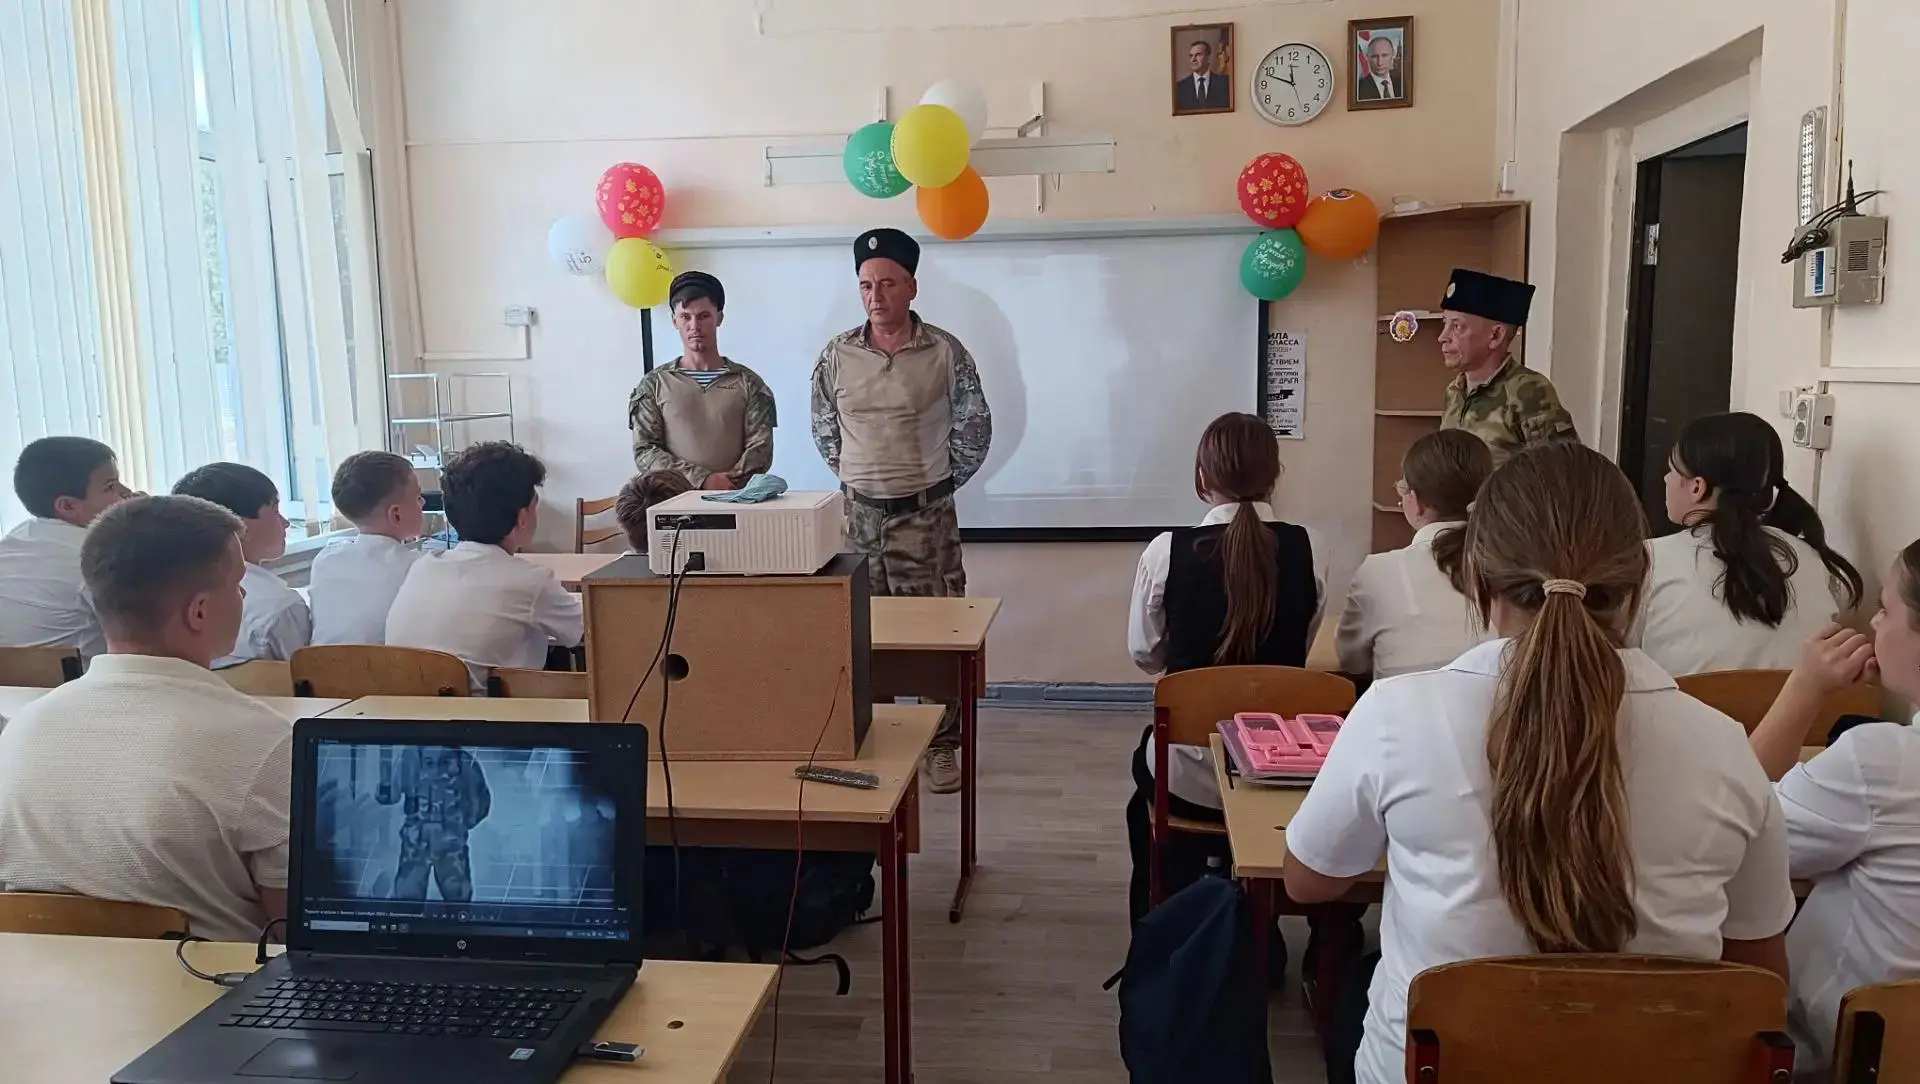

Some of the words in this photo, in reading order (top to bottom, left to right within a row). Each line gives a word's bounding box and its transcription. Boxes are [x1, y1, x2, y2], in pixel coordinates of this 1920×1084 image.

[1275, 56, 1284, 65] 11
[1288, 51, 1299, 61] 12
[1265, 66, 1275, 76] 10
[1314, 64, 1321, 74] 2
[1260, 80, 1268, 90] 9
[1318, 78, 1325, 88] 3
[1264, 94, 1271, 104] 8
[1313, 93, 1320, 102] 4
[1275, 104, 1282, 114] 7
[1288, 108, 1295, 118] 6
[1303, 103, 1310, 113] 5
